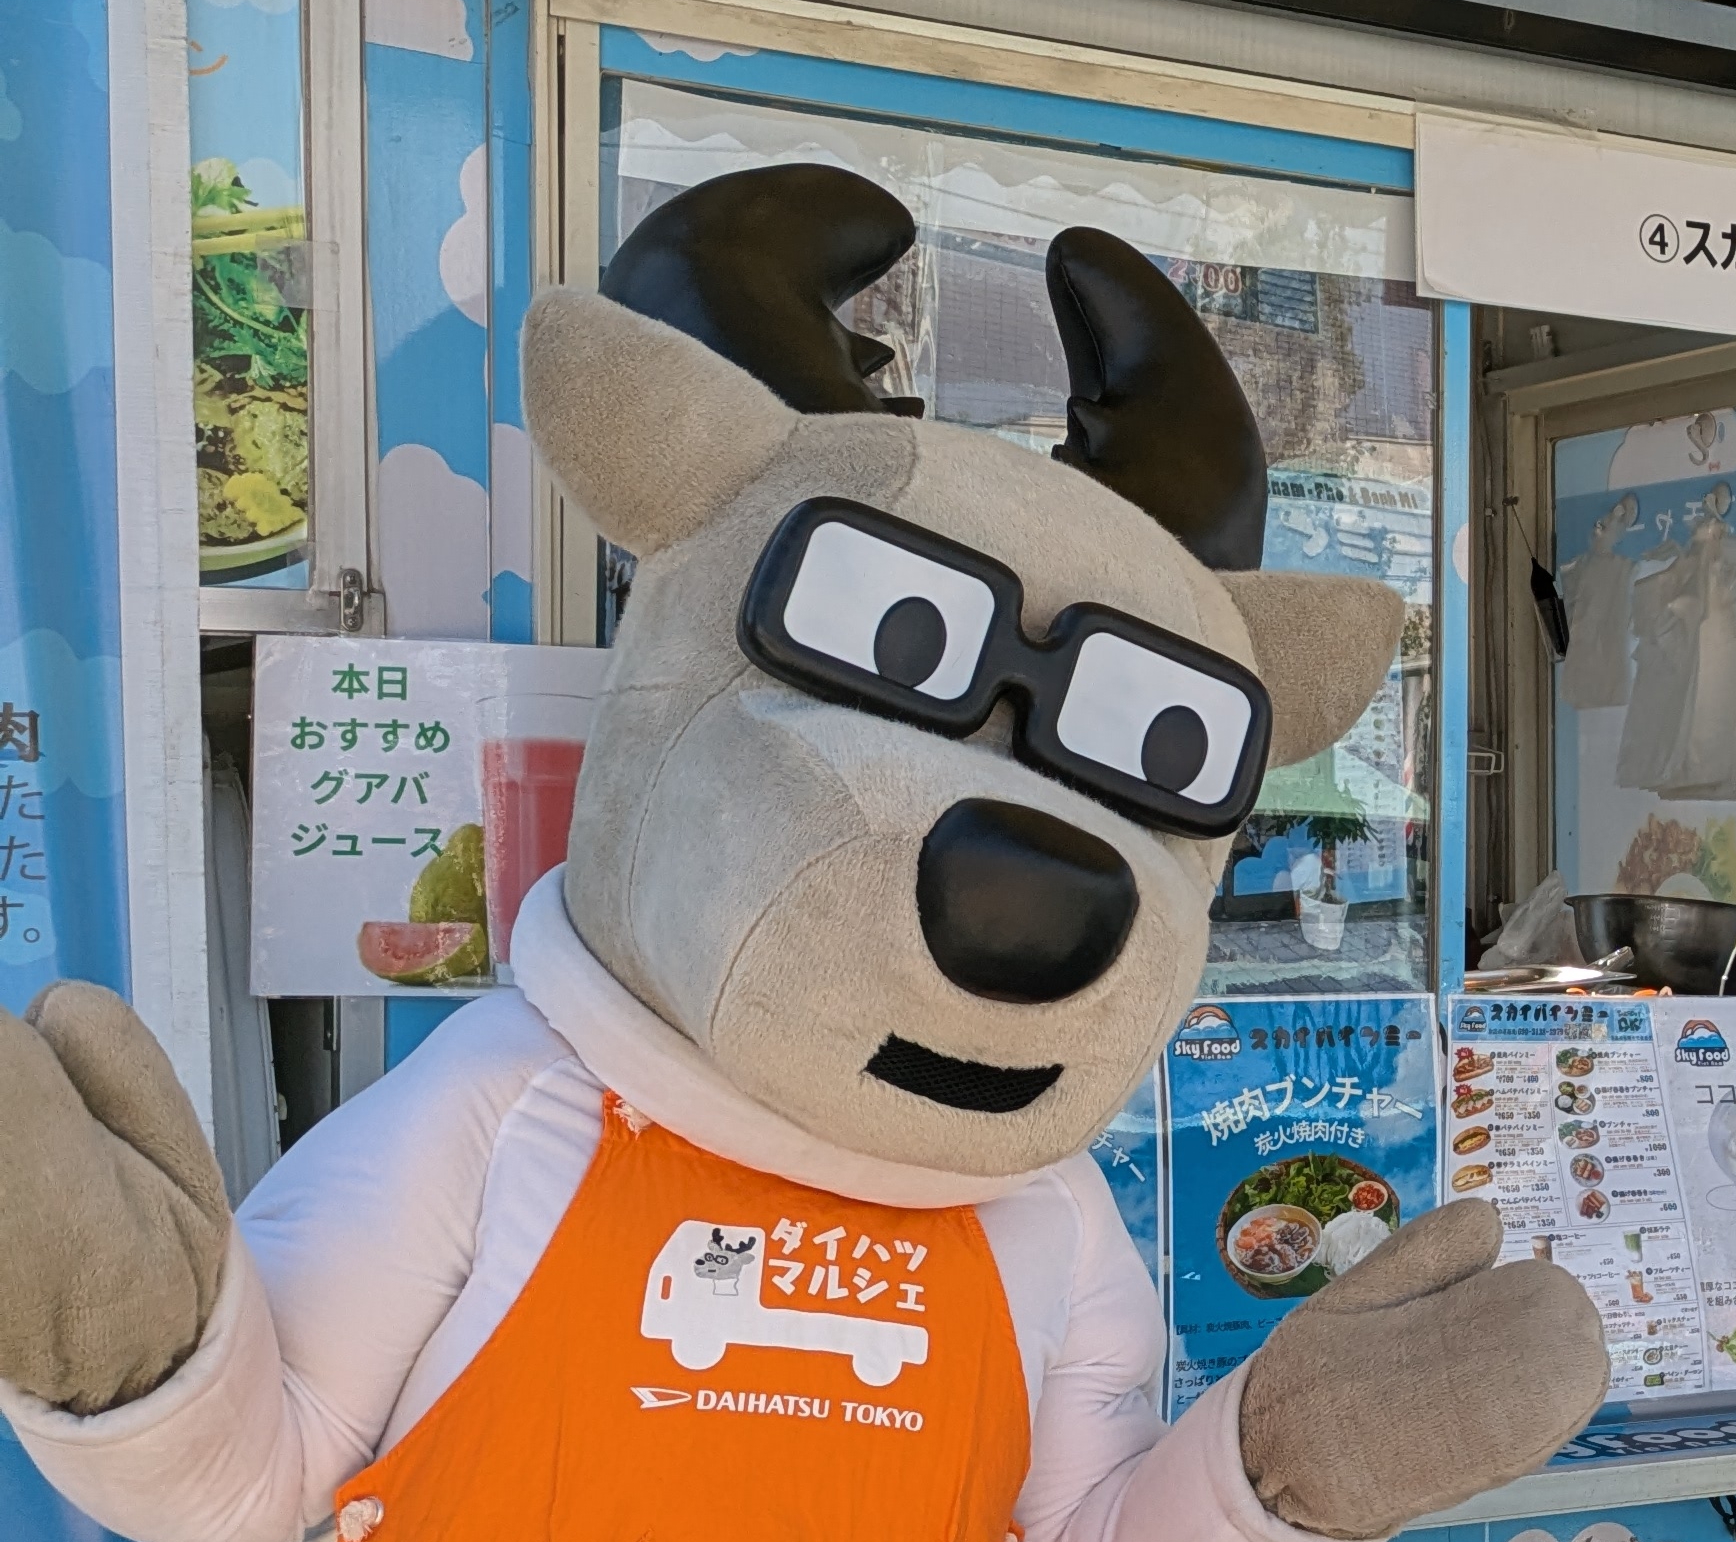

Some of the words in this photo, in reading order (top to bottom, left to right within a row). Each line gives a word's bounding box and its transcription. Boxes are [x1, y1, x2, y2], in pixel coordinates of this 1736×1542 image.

[331, 663, 408, 701] 本日
[289, 716, 451, 754] おすすめ
[310, 769, 431, 805] グアバ
[290, 823, 444, 858] ジュース
[1174, 1040, 1200, 1059] Sky
[1203, 1040, 1241, 1056] Food
[1674, 1047, 1696, 1066] Sky
[1697, 1047, 1730, 1062] Food
[1201, 1073, 1423, 1147] 焼肉ブンチャー
[1254, 1120, 1366, 1157] 炭火焼肉付き
[770, 1217, 928, 1272] ダイハツ
[768, 1258, 926, 1312] マルシェ
[696, 1389, 830, 1419] DAIHATSU
[841, 1401, 924, 1432] TOKYO
